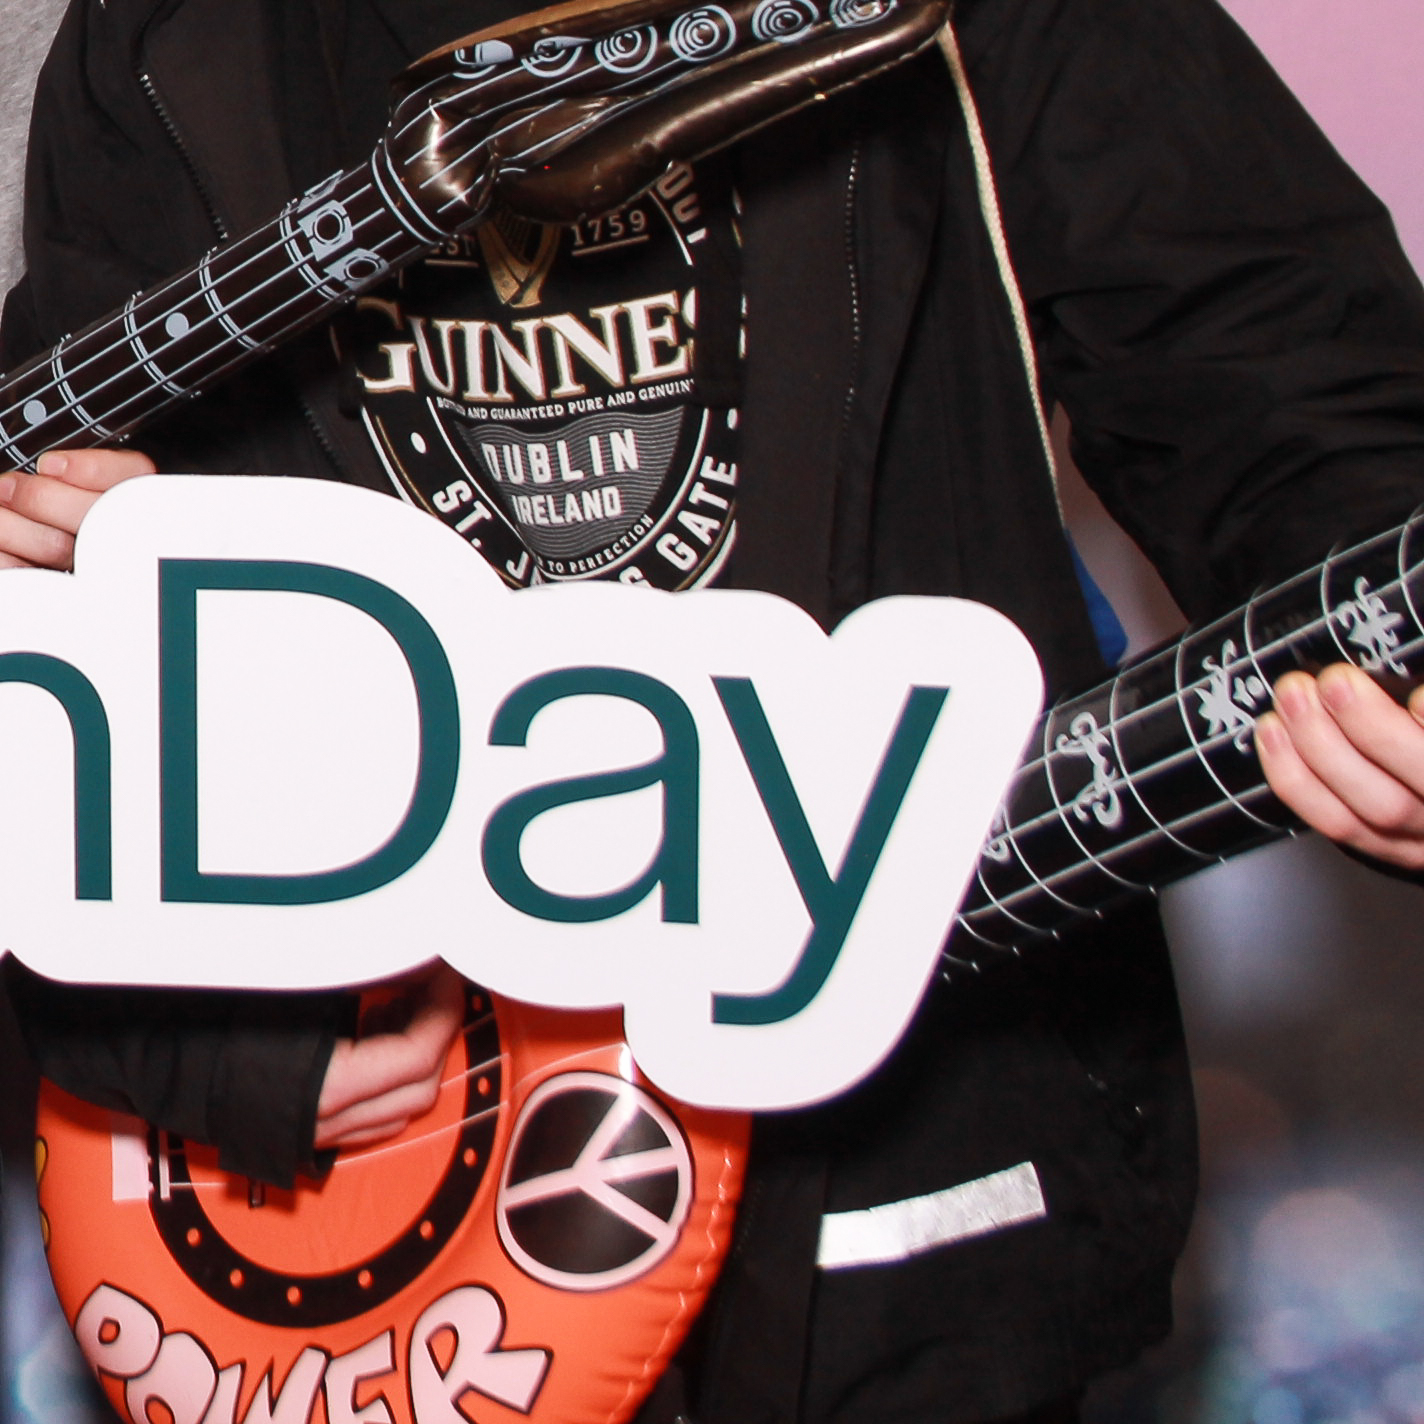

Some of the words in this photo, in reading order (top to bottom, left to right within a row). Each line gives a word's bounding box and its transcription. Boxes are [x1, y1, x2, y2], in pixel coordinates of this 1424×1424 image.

[571, 208, 648, 247] 1759
[467, 406, 488, 419] AND
[490, 403, 566, 420] GUARANTEED
[568, 396, 604, 415] PURE
[607, 390, 636, 407] AND
[638, 379, 696, 401] GENUIN
[481, 428, 639, 484] DUBLIN
[512, 486, 622, 526] IRELAND
[655, 455, 739, 572] GATE
[548, 561, 565, 573] TO
[570, 514, 654, 574] PERFECTION
